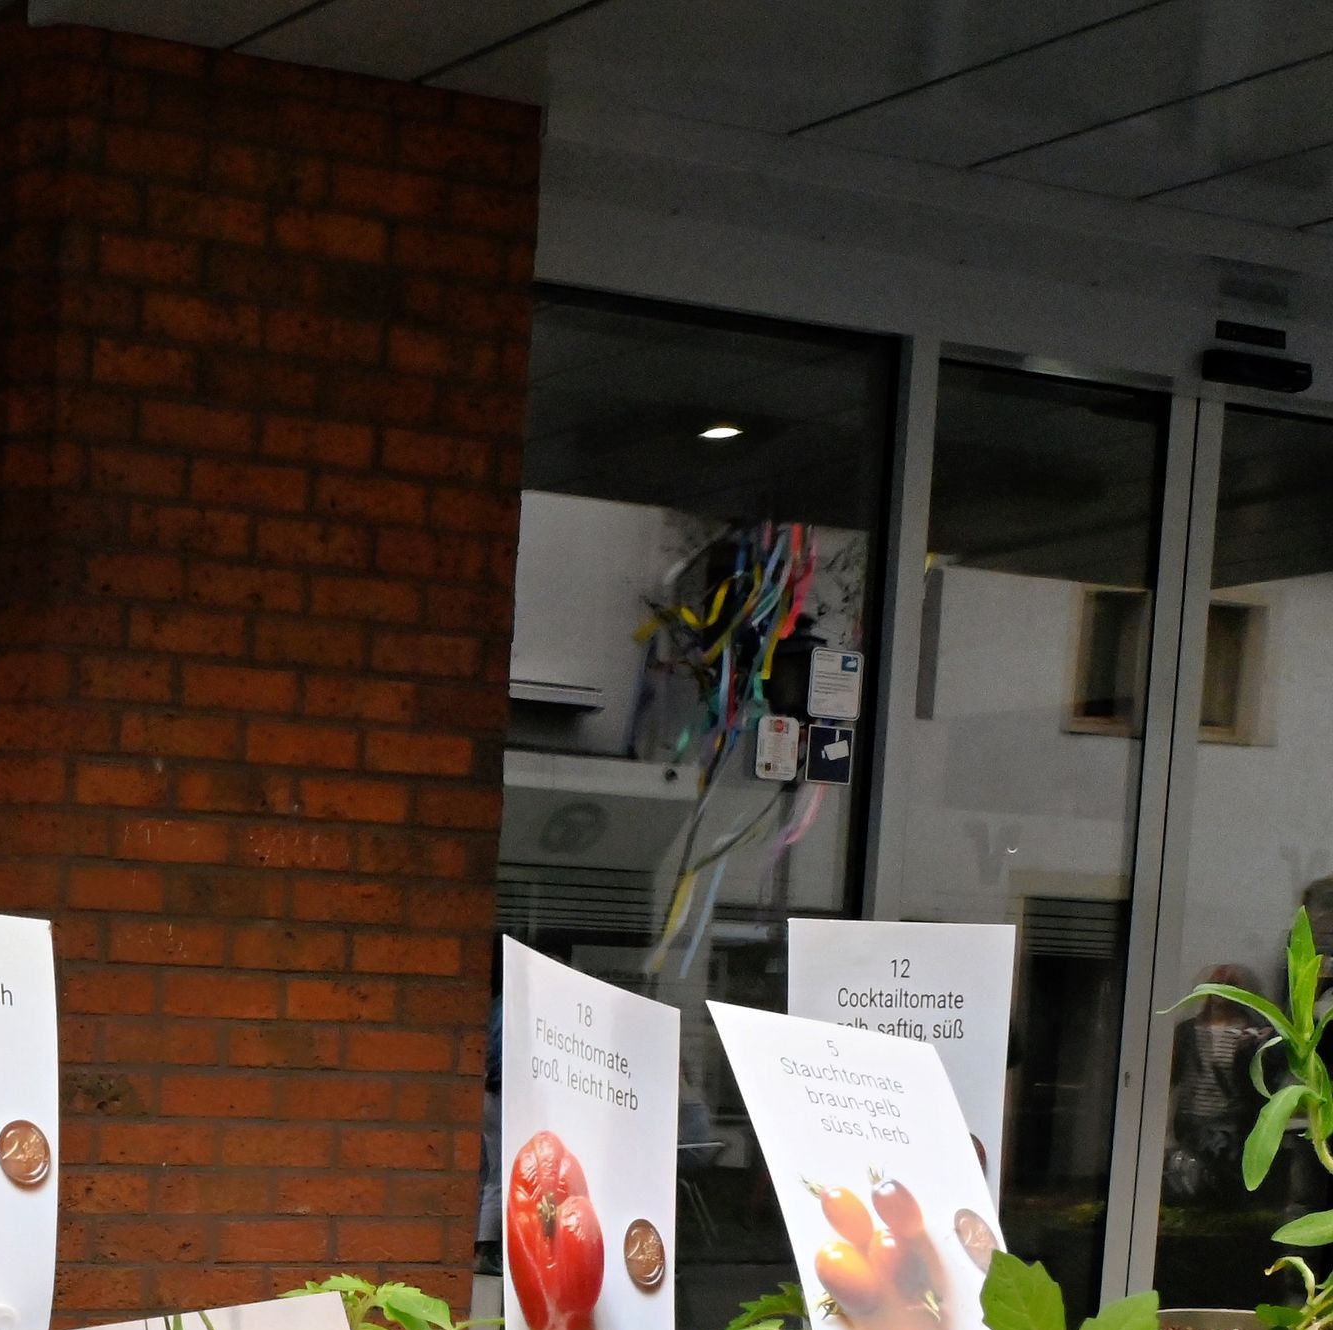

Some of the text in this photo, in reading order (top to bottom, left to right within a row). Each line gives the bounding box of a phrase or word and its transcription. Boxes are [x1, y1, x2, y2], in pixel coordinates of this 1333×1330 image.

[890, 958, 911, 978] 12
[837, 987, 964, 1009] Cocktailtomate
[576, 1002, 593, 1028] 18
[933, 1018, 965, 1040] süß
[536, 1018, 632, 1079] Fleischtomate,
[826, 1040, 840, 1057] 5
[567, 1064, 603, 1100] leicht
[607, 1082, 639, 1111] herb
[780, 1057, 905, 1095] Stauchtomate
[805, 1085, 901, 1118] braun-gelb
[821, 1115, 910, 1145] süss, herb
